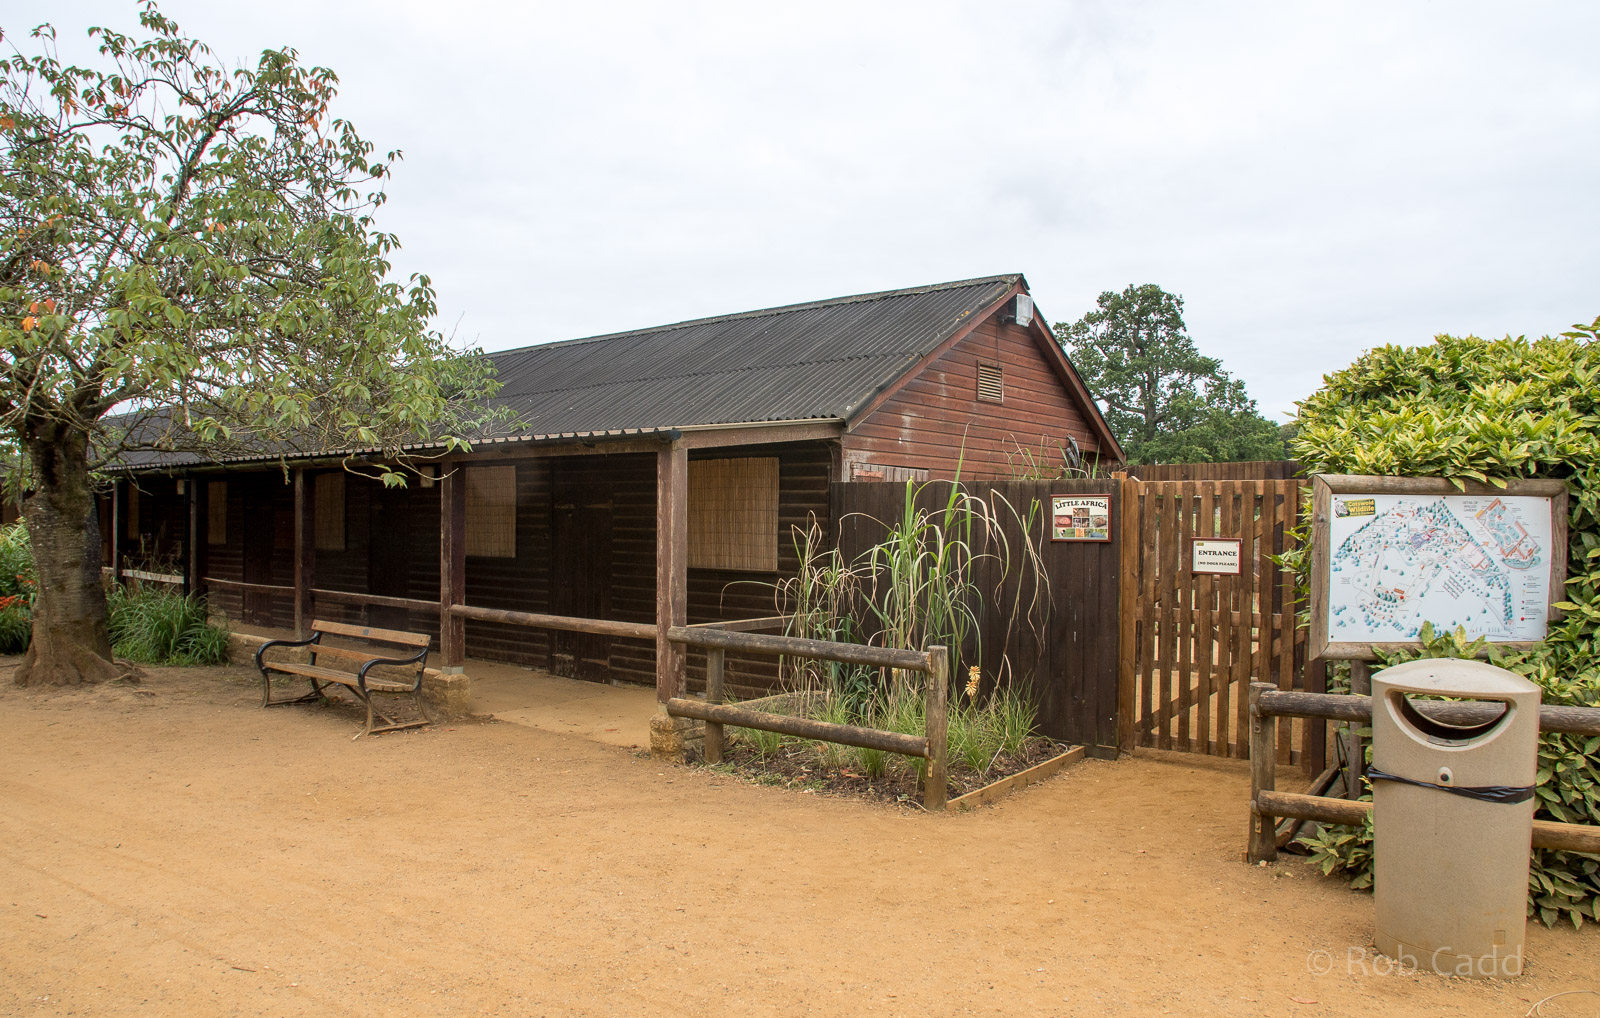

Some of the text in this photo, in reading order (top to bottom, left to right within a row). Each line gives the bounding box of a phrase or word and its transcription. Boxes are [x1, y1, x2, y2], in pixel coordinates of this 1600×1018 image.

[1055, 500, 1107, 510] LITTLE AFRICA
[1349, 505, 1375, 513] Wildlife
